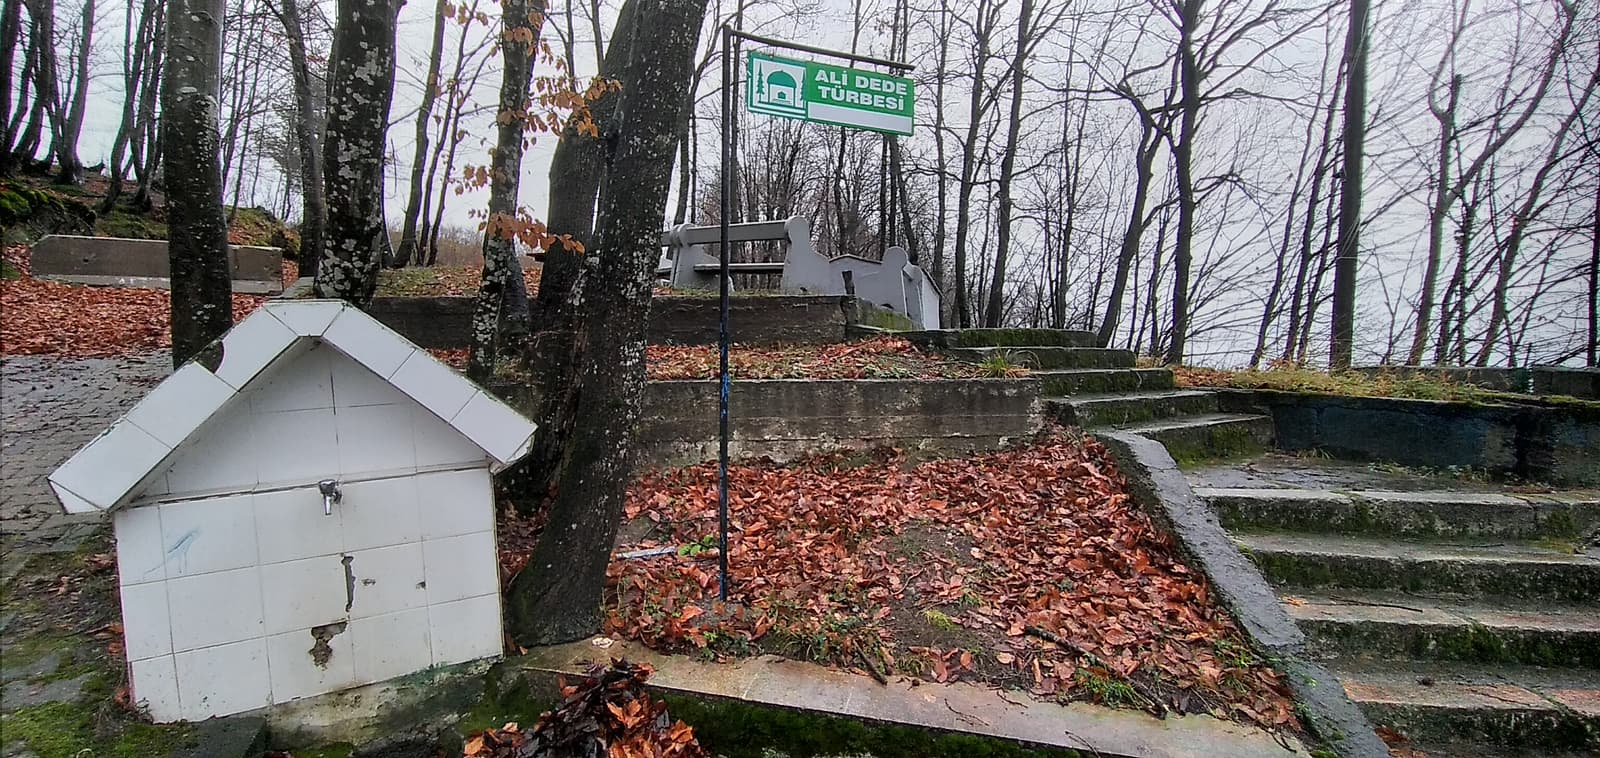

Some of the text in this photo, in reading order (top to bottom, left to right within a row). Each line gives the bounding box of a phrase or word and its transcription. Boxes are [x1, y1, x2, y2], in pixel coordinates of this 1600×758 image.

[815, 70, 907, 95] ALİ DEDE
[817, 85, 904, 110] TÜRBESİ
